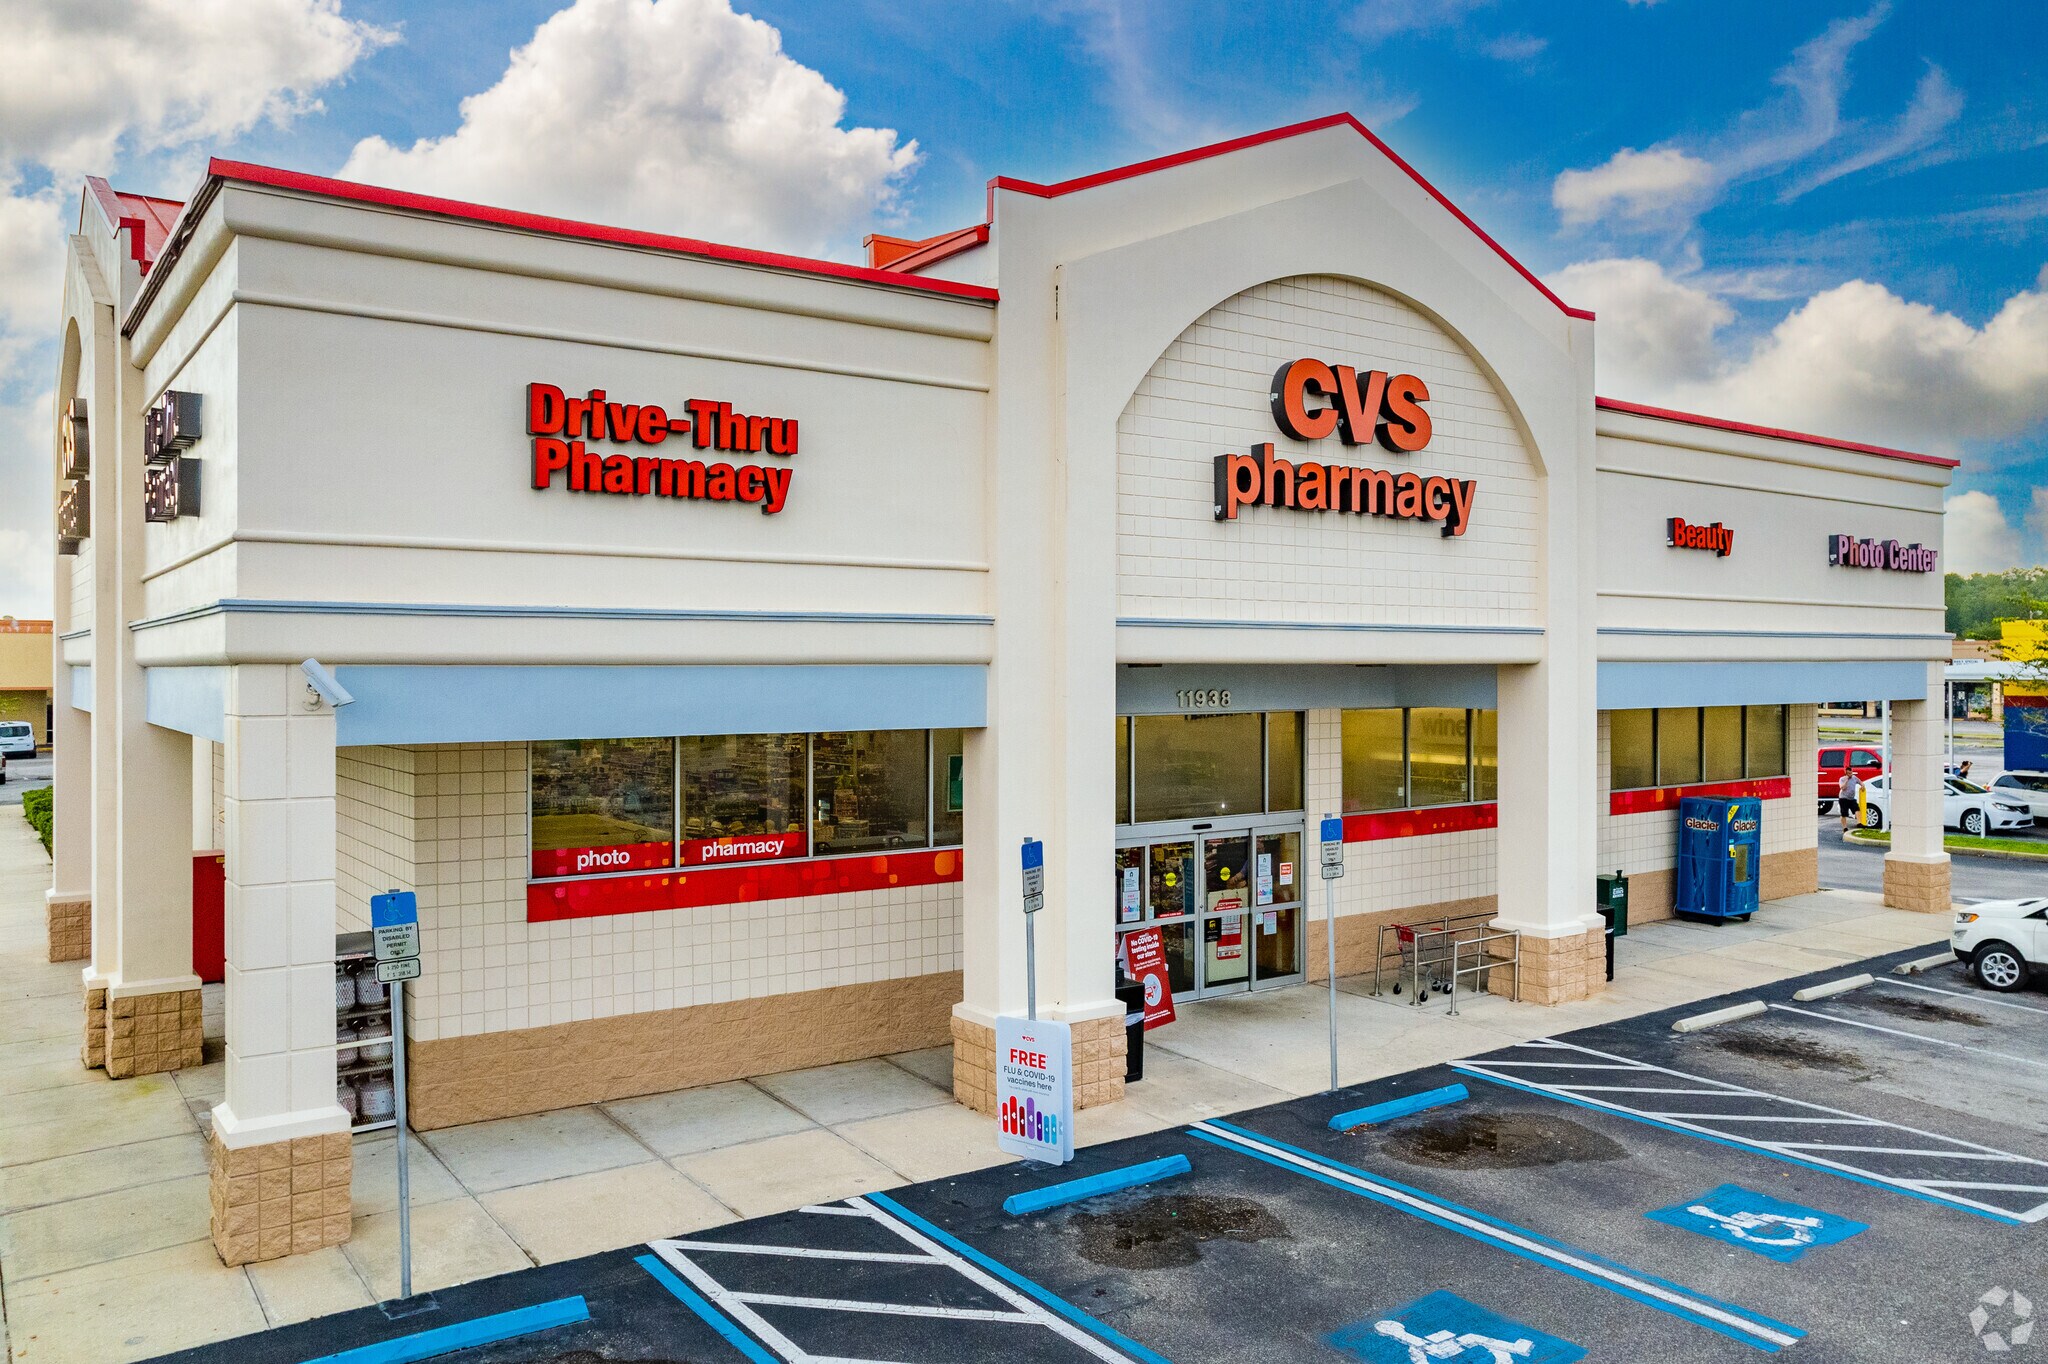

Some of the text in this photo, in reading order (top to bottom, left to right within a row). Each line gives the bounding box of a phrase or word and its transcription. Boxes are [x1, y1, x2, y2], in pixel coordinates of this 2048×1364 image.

[1275, 358, 1432, 452] CVS
[526, 382, 798, 455] Drive-Thru
[531, 437, 793, 514] Pharmacy
[1217, 443, 1477, 537] pharmacy
[1668, 517, 1734, 557] Beauty
[1833, 534, 1938, 572] Photo Center
[1176, 690, 1231, 708] 11938
[1421, 713, 1466, 737] wine
[1685, 817, 1720, 832] Glacier
[1732, 819, 1758, 832] Glacier
[576, 849, 631, 871] photo
[701, 837, 785, 861] pharmacy
[1131, 941, 1160, 954] testing inside
[1138, 934, 1159, 945] COVID-19
[1003, 1065, 1056, 1083] FLU & COVID-19
[1006, 1076, 1037, 1089] vaccines
[1036, 1080, 1053, 1092] here
